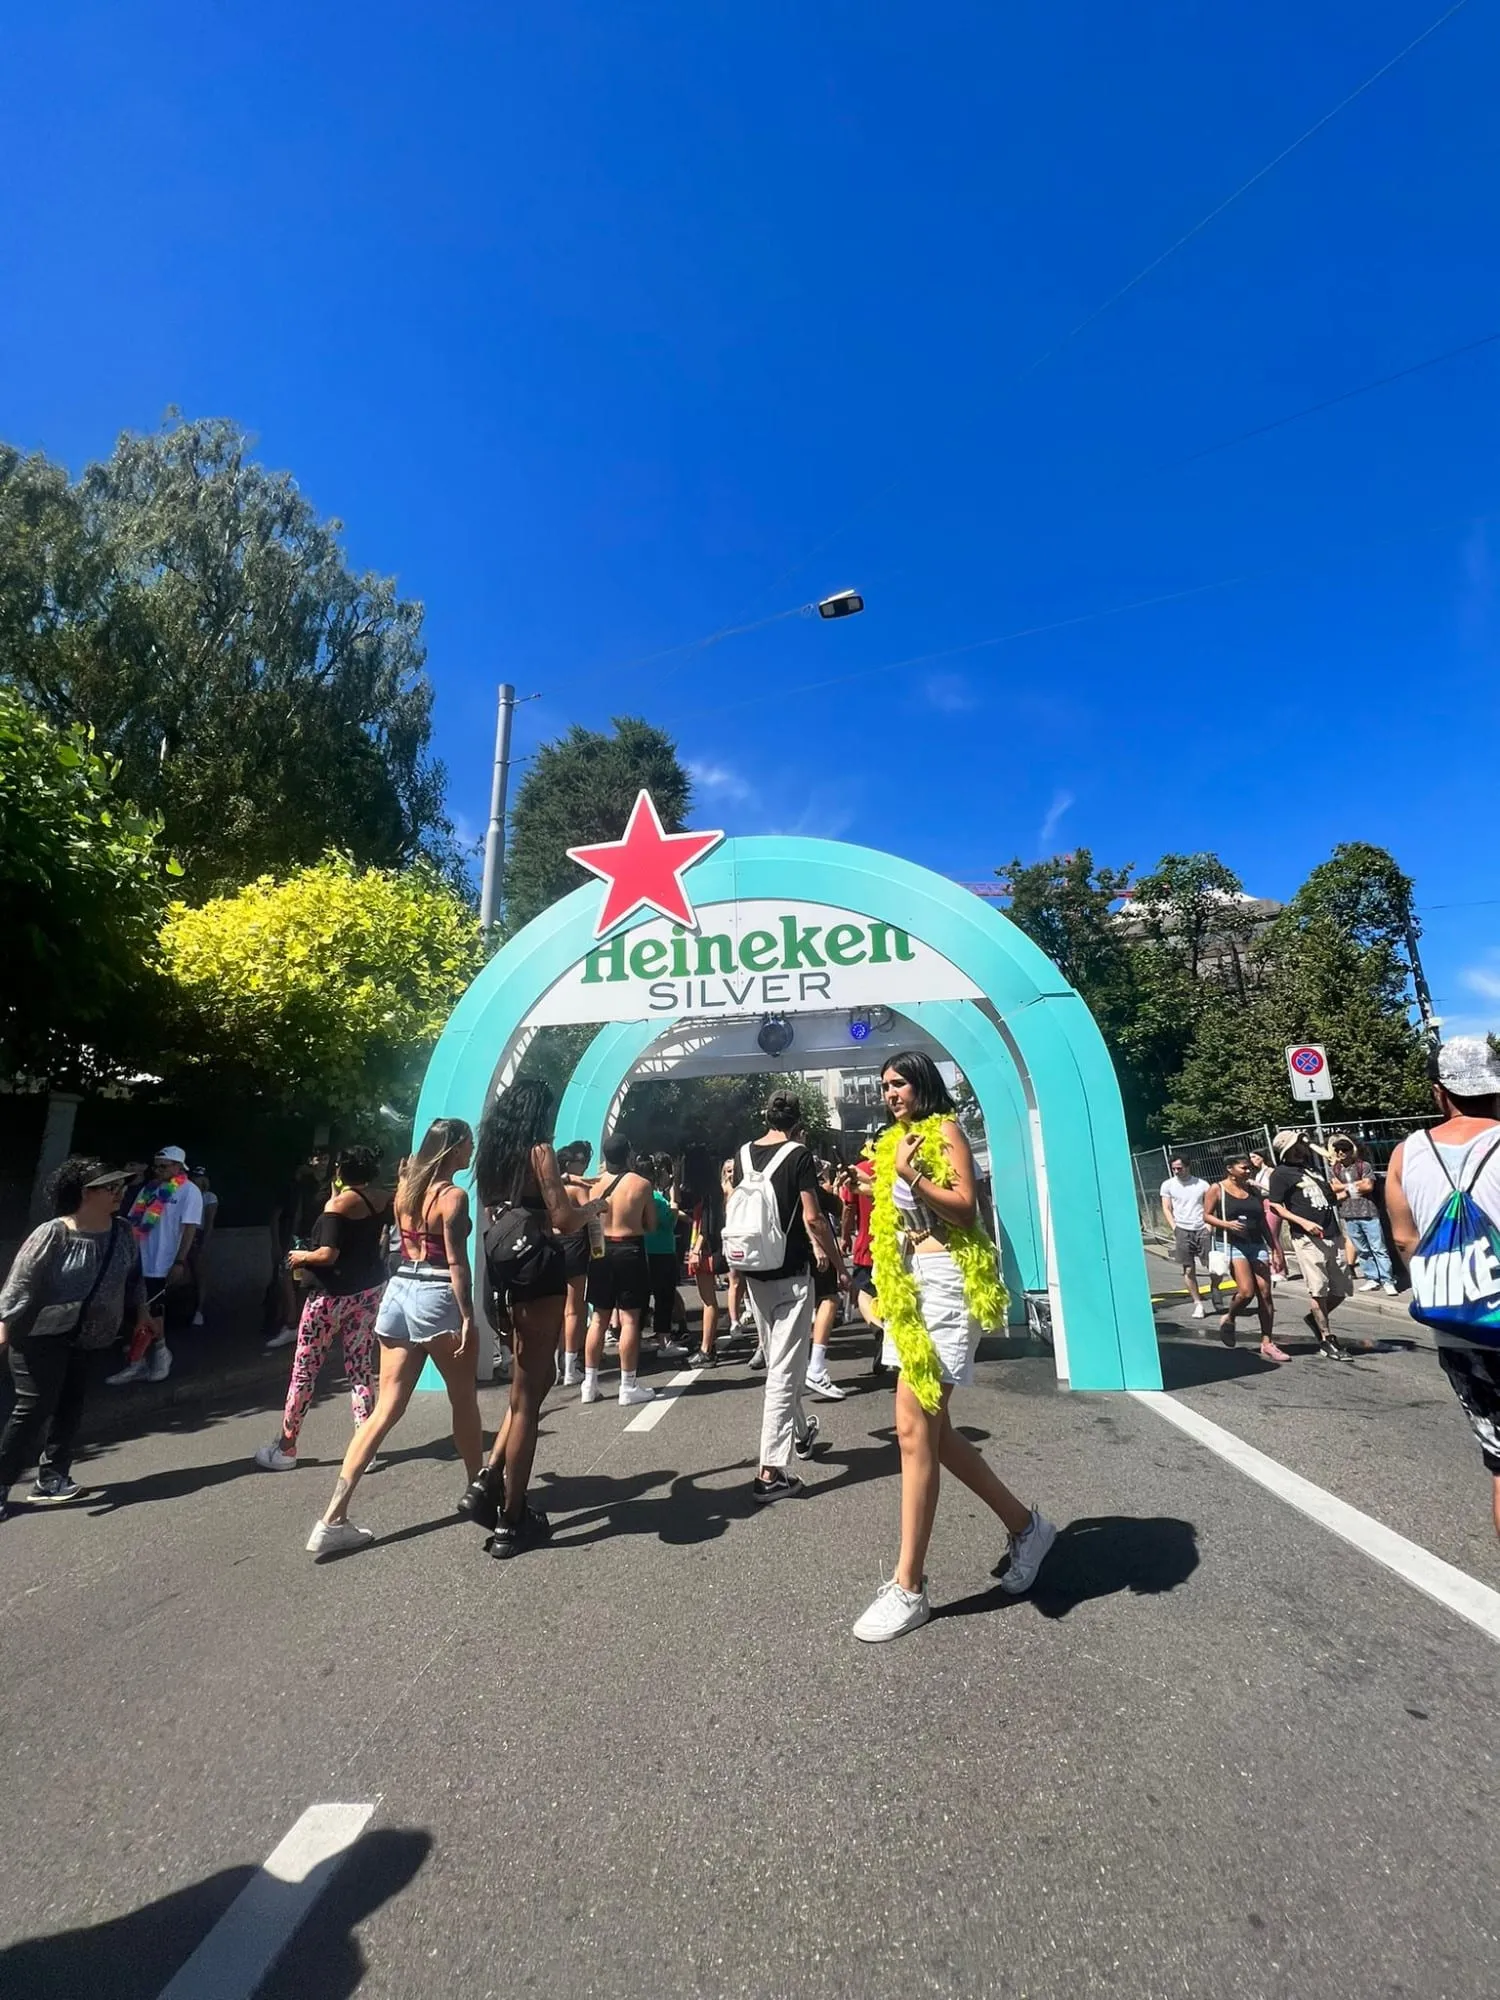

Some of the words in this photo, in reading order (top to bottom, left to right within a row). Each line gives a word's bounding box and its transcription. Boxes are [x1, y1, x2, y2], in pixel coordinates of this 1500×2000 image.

[580, 915, 916, 984] Heineken
[648, 971, 832, 1011] SILVER
[1409, 1236, 1500, 1308] NIKE
